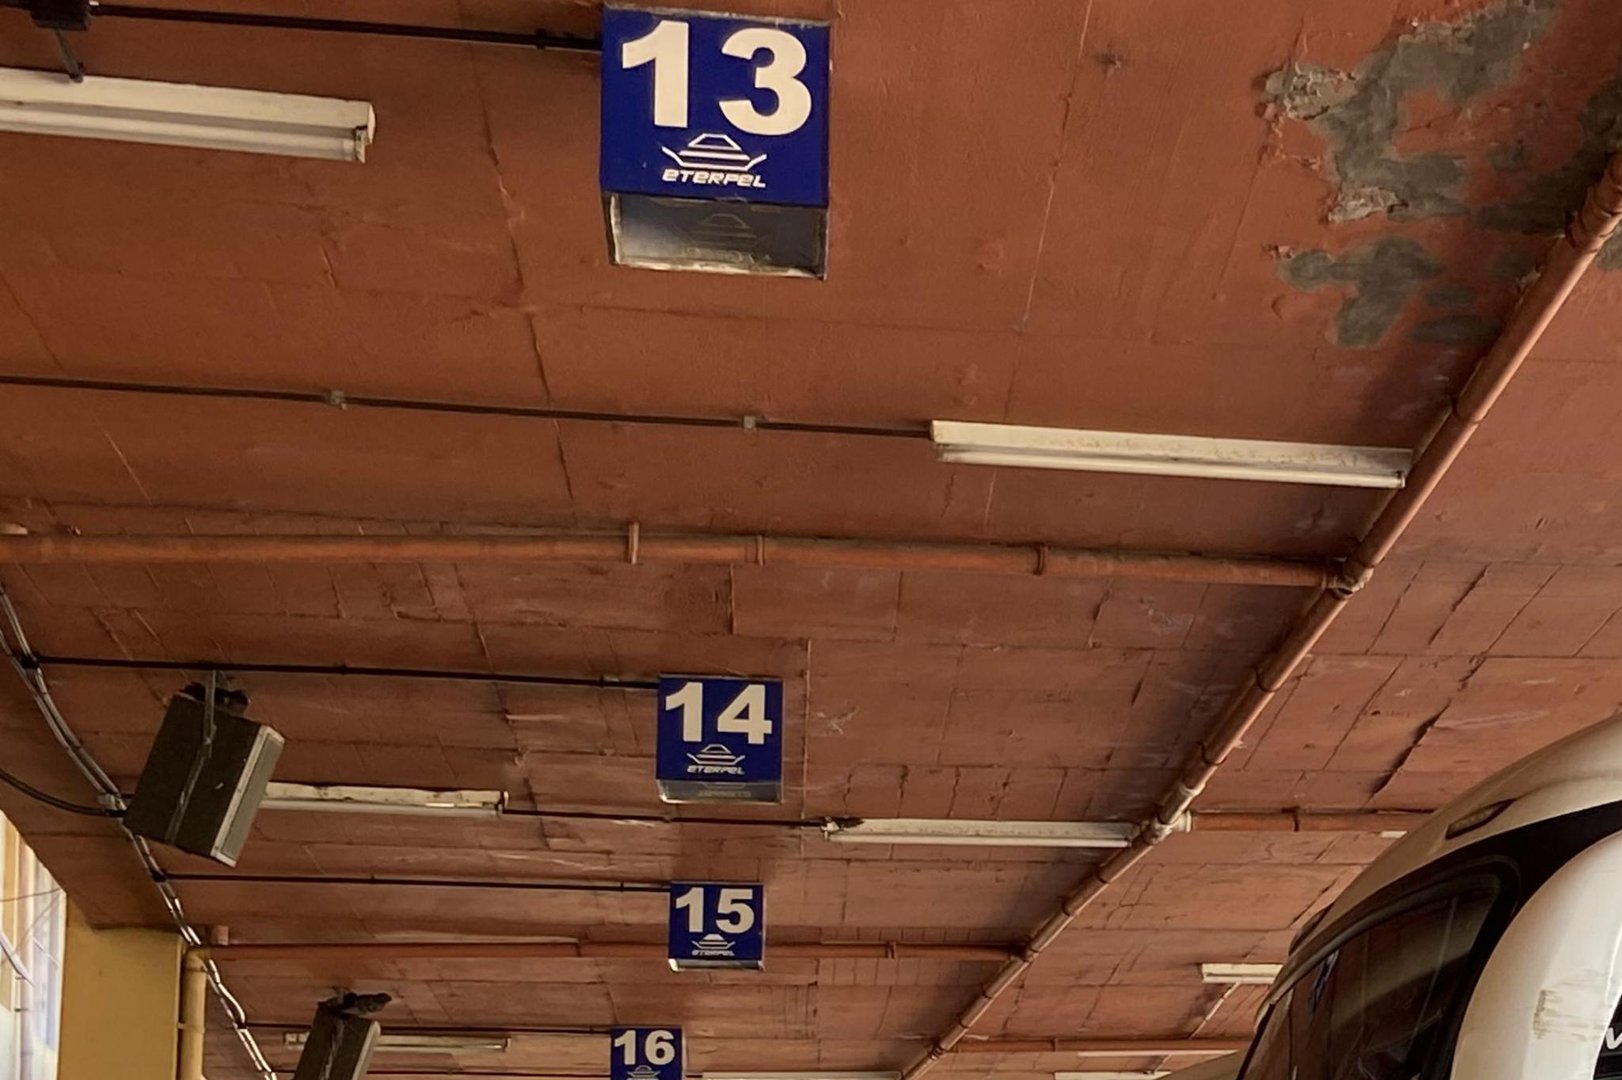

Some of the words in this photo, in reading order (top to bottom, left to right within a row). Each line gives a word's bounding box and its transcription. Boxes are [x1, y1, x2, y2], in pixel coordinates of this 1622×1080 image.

[622, 20, 812, 136] 13
[665, 681, 773, 745] 14
[675, 886, 755, 934] 15
[614, 1029, 676, 1066] 16
